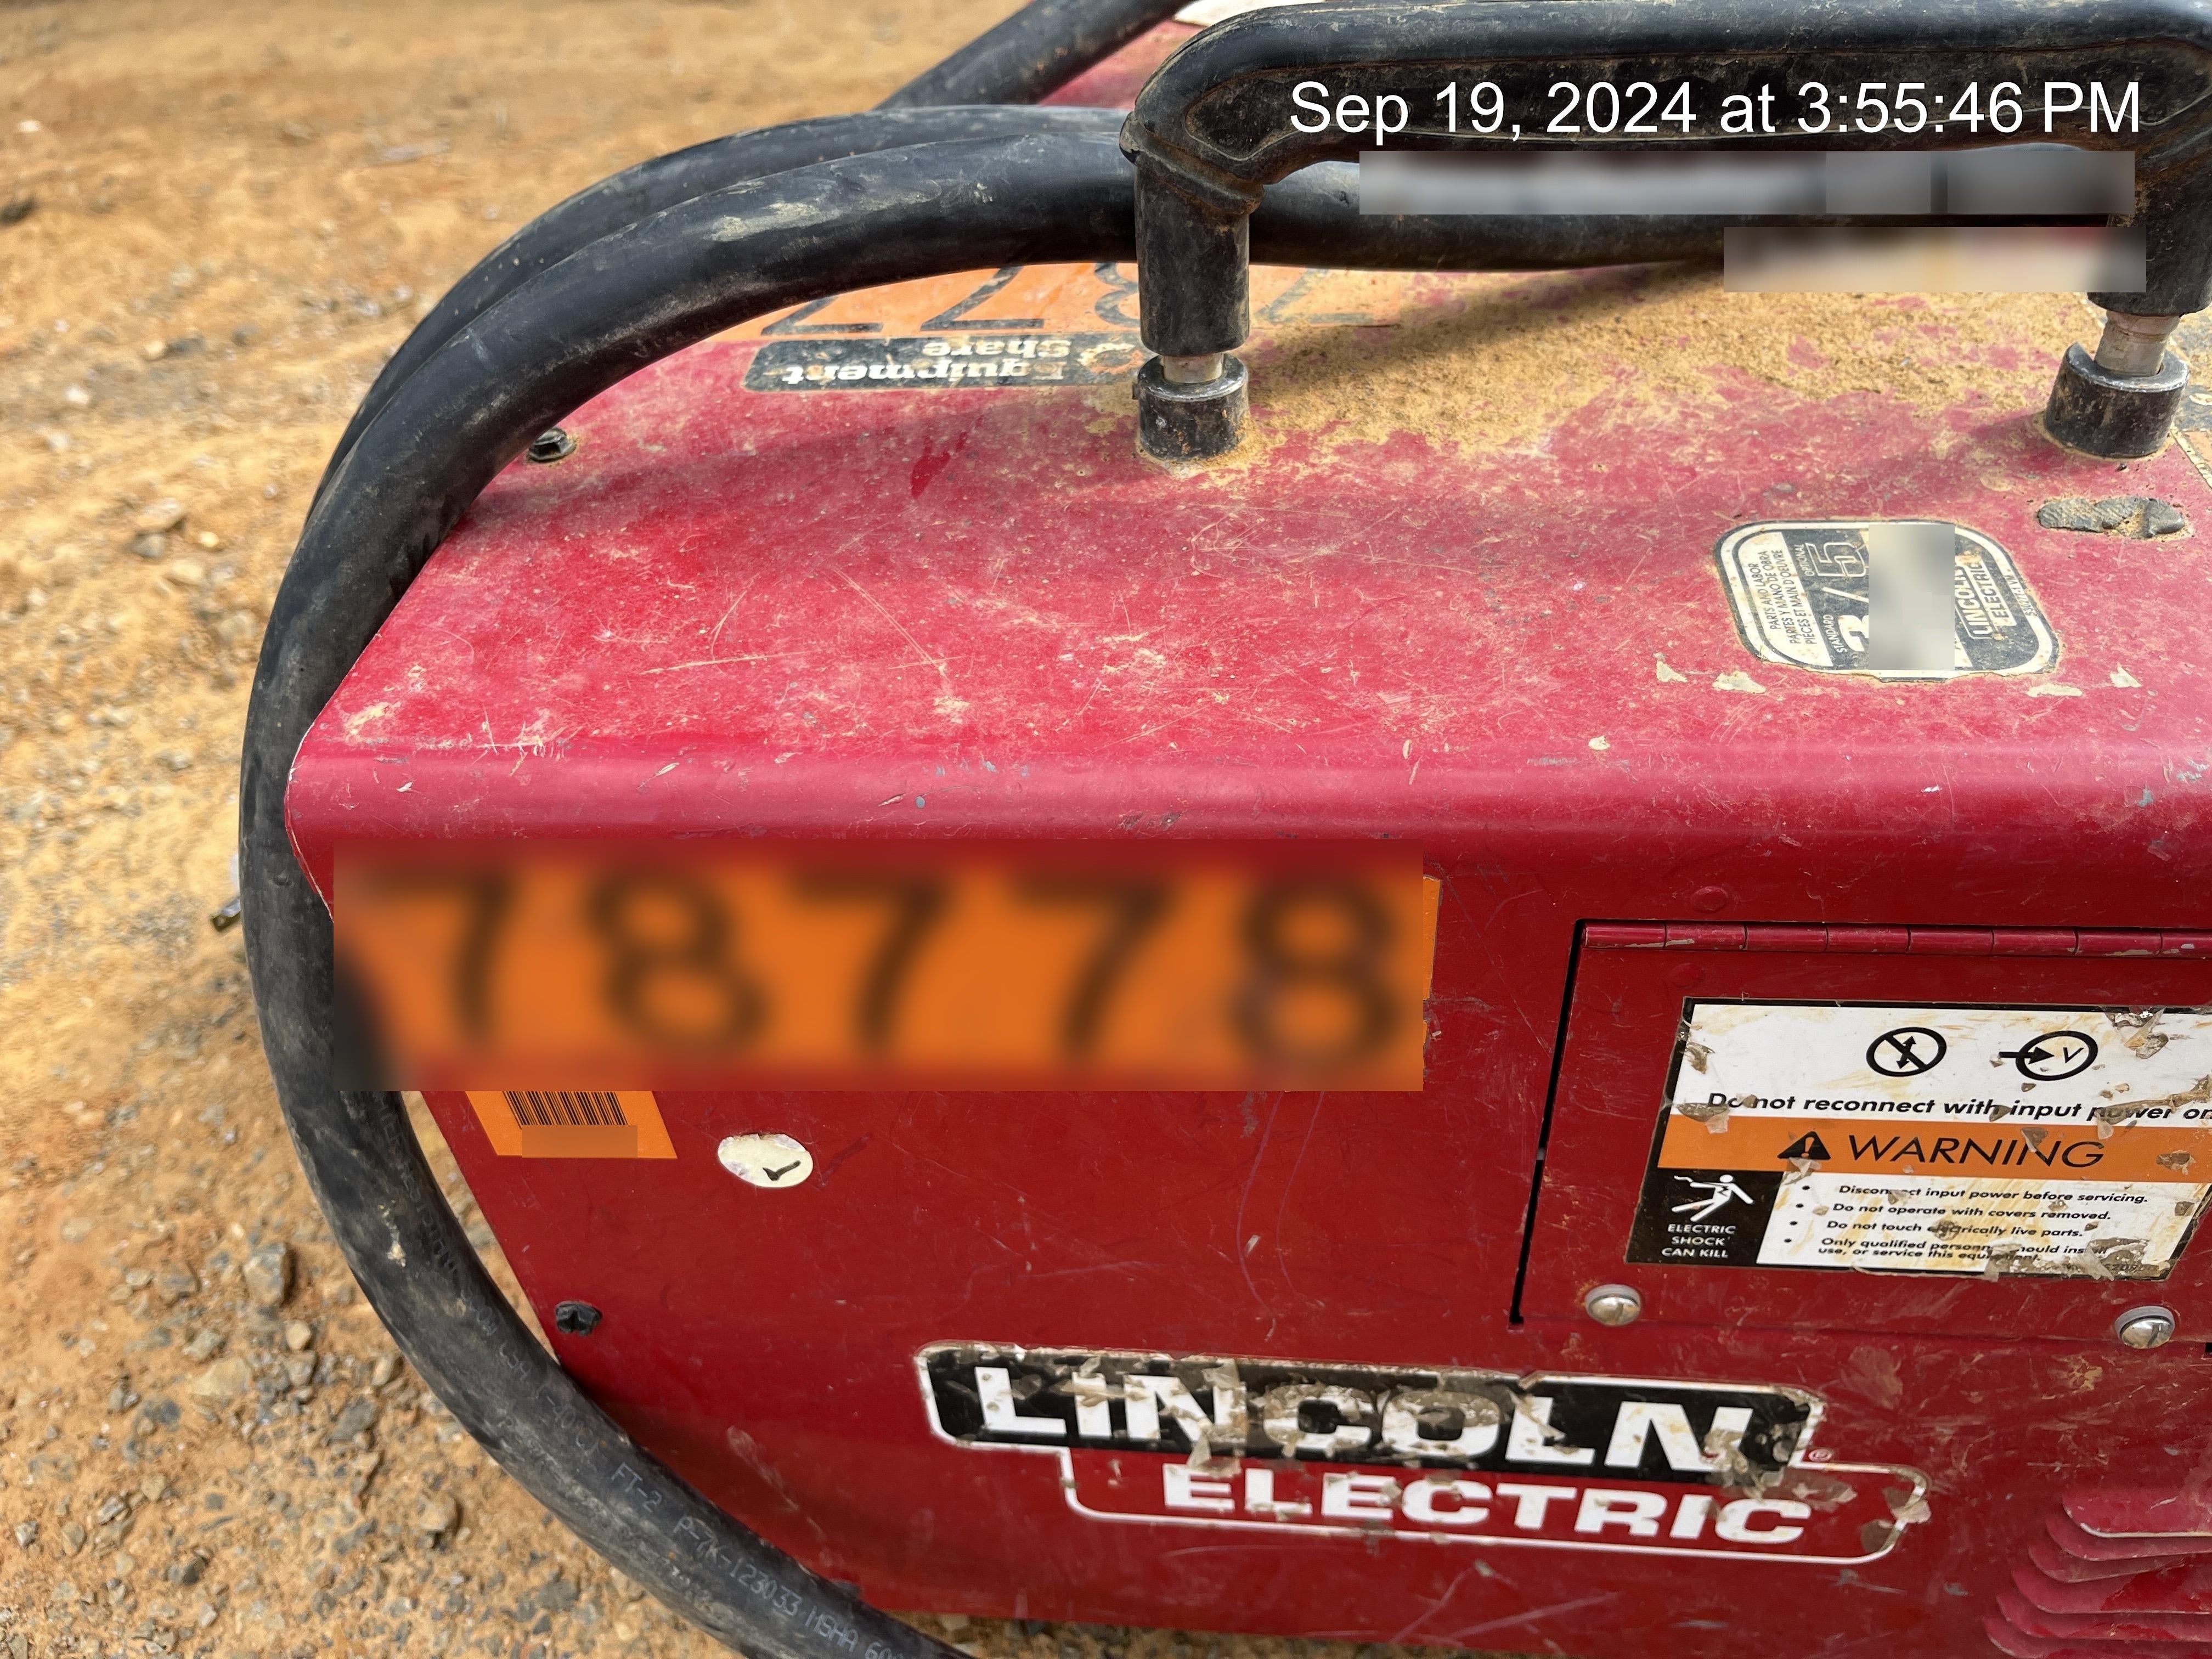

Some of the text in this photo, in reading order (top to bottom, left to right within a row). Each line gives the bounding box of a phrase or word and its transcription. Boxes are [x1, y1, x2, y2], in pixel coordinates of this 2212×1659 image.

[923, 340, 1071, 360] Share
[781, 360, 1066, 386] Equipment
[1758, 550, 1774, 571] OBRA
[1794, 544, 1815, 577] OPTIONAL
[1764, 572, 1779, 583] DE
[1748, 563, 1781, 630] PARTS AND LABOR
[1769, 584, 1788, 608] MANO
[1786, 586, 1804, 608] MAIN
[1968, 561, 2010, 618] ELECTRIC
[1793, 608, 1807, 617] ET
[1781, 617, 1802, 645] PARTES
[1822, 614, 1848, 653] STANDARD
[1754, 1096, 1796, 1110] not
[1803, 1098, 1936, 1114] reconnect
[1943, 1098, 2000, 1117] with
[2009, 1099, 2083, 1120] input
[1848, 1134, 2105, 1168] WARNING
[1925, 1187, 1966, 1199] input
[1968, 1190, 2020, 1200] power
[2023, 1190, 2074, 1201] before
[2077, 1193, 2148, 1204] servicing.
[1832, 1203, 2112, 1220] Do not operate with covers removed.
[1667, 1223, 1737, 1235] ELECTRIC
[1826, 1220, 1848, 1229] Do
[1852, 1222, 1877, 1231] not
[1881, 1223, 1922, 1232] touch
[2011, 1226, 2038, 1235] live
[2040, 1228, 2084, 1238] parts.
[1671, 1236, 1726, 1246] SHOCK
[1821, 1237, 1857, 1249] Only
[1860, 1239, 1927, 1250] qualified
[2013, 1245, 2061, 1254] hould
[1661, 1247, 1729, 1259] CAN KILL
[1818, 1247, 1848, 1256] use,
[1872, 1249, 1924, 1257] service
[1927, 1249, 1954, 1259] this
[975, 1365, 1754, 1474] LINCOLN
[1161, 1463, 1812, 1544] ELECTRIC
[610, 1460, 664, 1513] FT-2
[804, 1605, 860, 1652] MSHA
